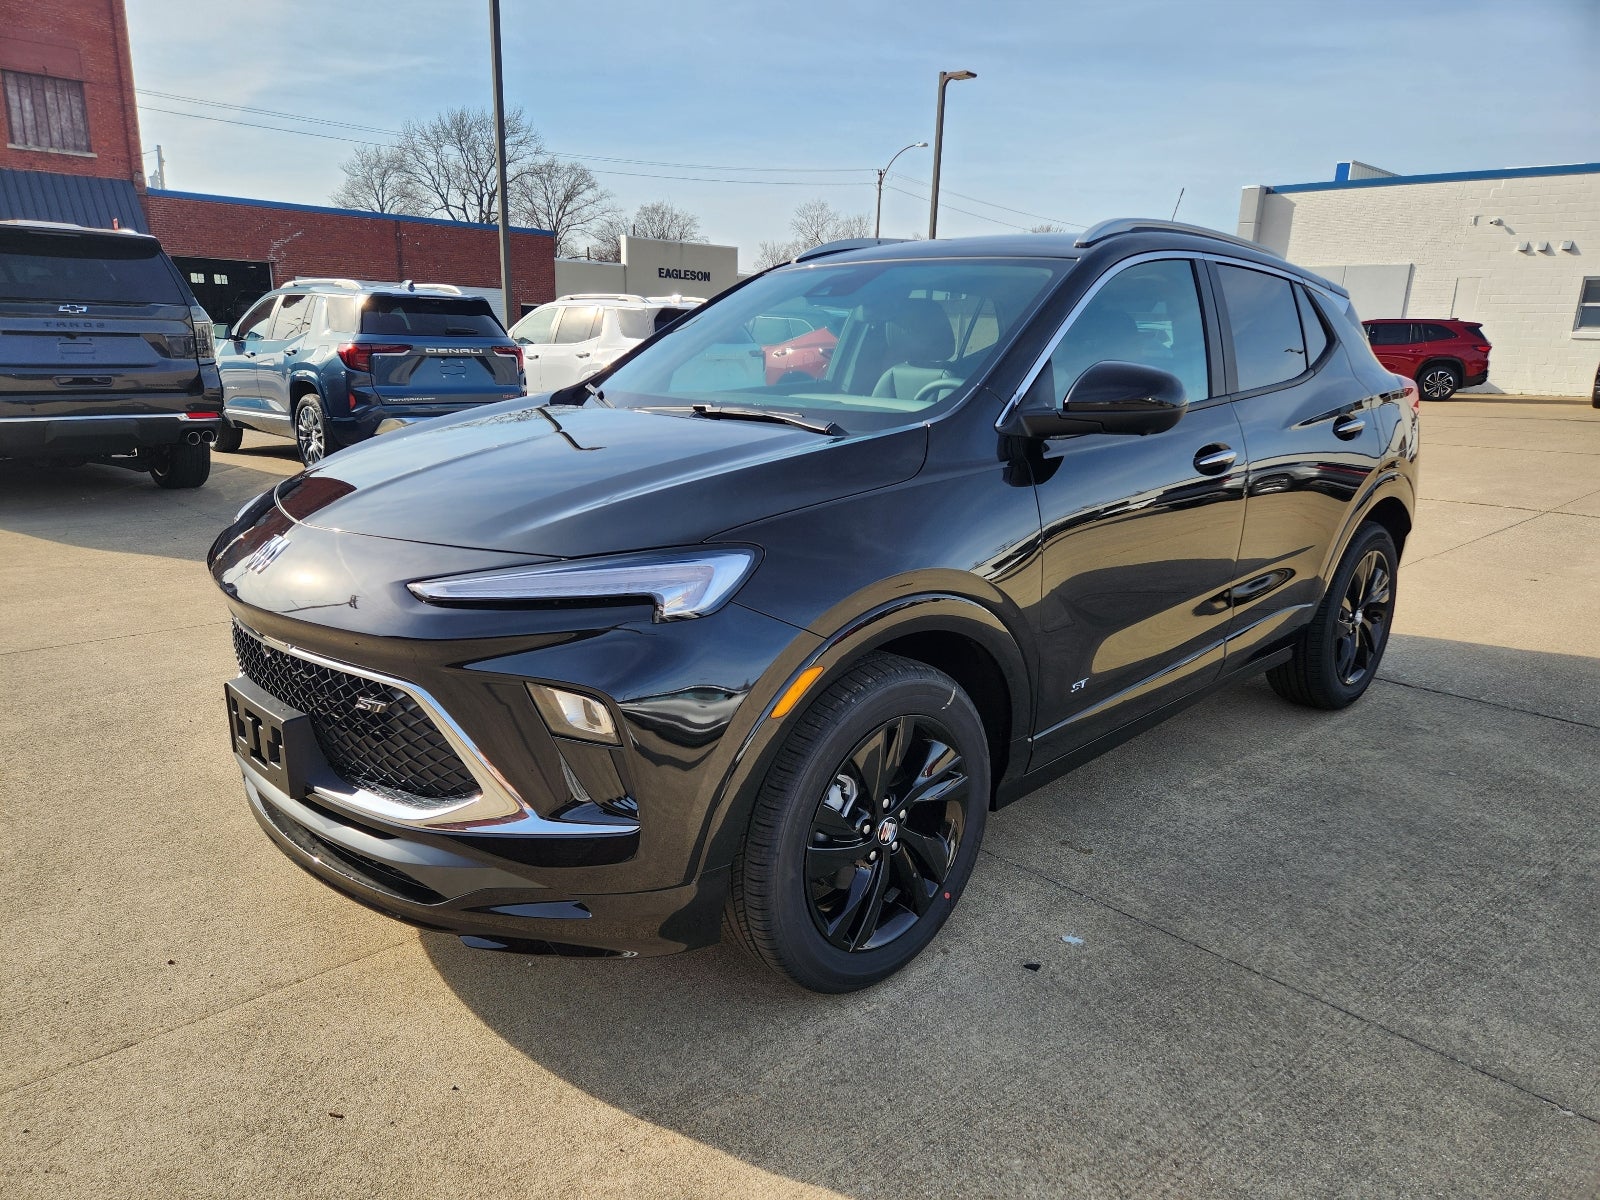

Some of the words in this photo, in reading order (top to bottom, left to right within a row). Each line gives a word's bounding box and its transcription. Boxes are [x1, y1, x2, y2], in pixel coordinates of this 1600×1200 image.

[658, 267, 711, 282] EAGLESON
[1070, 677, 1090, 693] ST
[354, 695, 387, 713] ST
